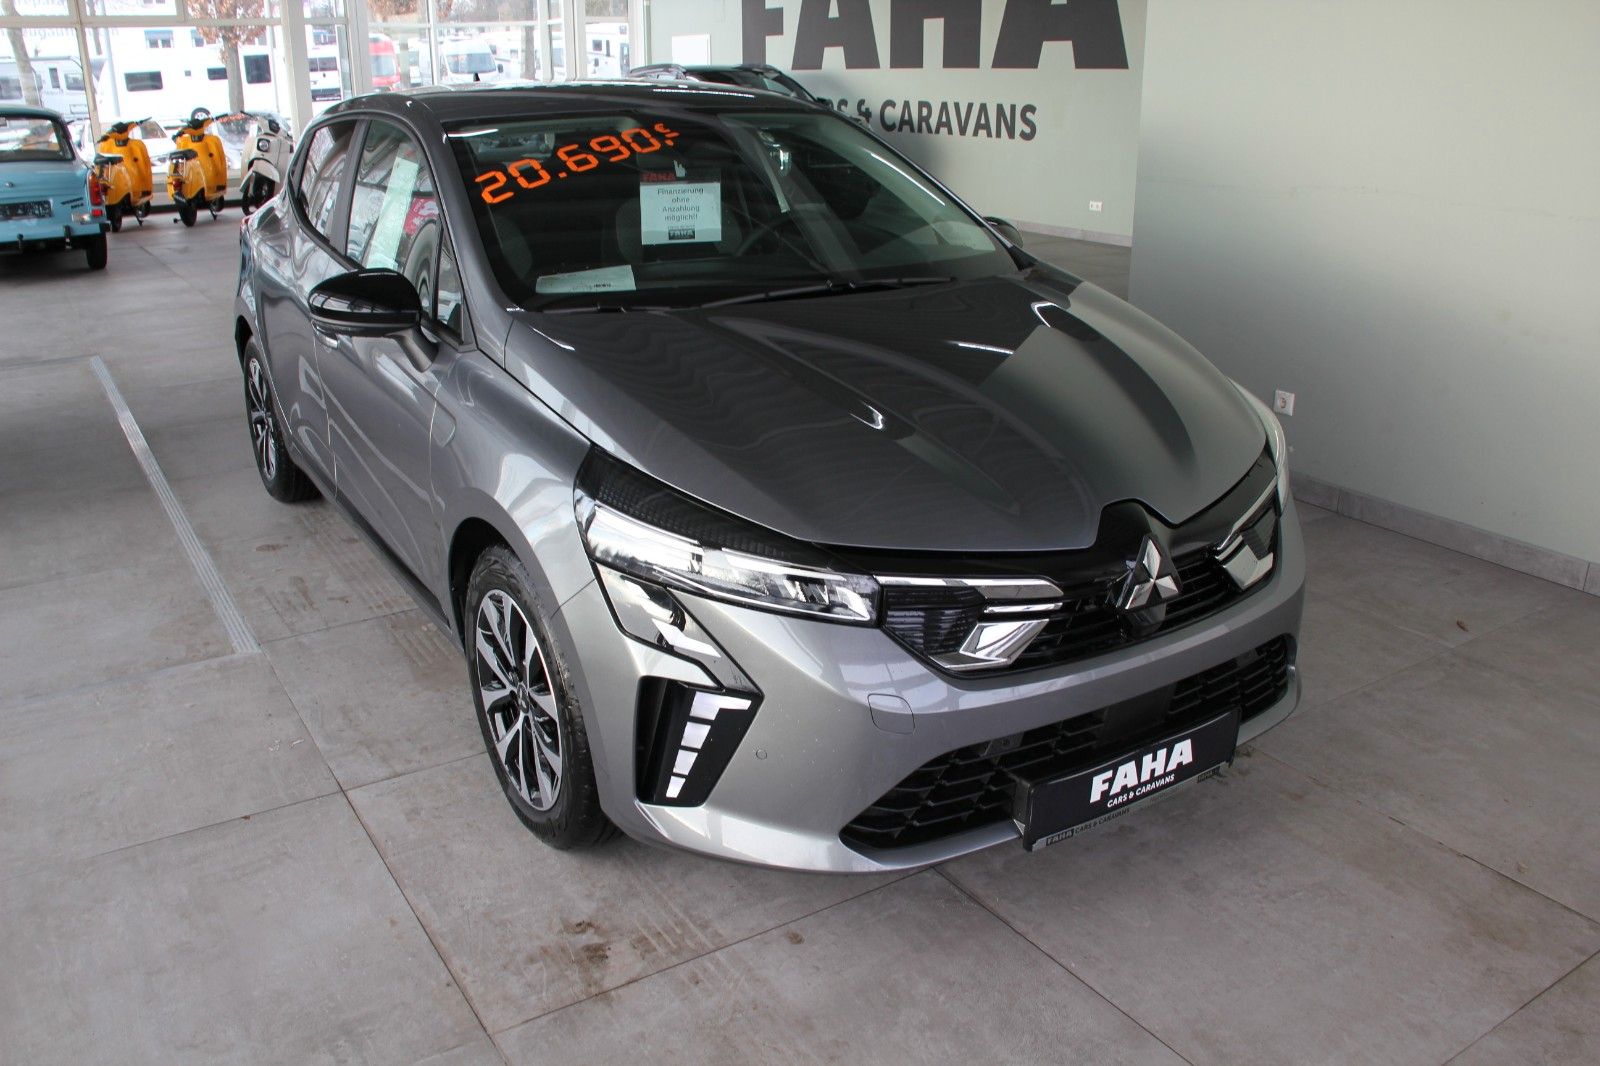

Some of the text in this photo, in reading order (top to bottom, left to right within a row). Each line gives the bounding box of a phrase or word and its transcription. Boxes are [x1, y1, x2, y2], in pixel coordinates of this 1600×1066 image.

[742, 0, 1128, 71] FAHA
[879, 99, 1037, 142] CARAVANS
[657, 187, 704, 195] Finanzierung
[662, 205, 700, 213] Anzahlung
[1090, 739, 1193, 803] FAHA
[1107, 793, 1128, 808] CARS
[1136, 774, 1175, 796] CARAVANS
